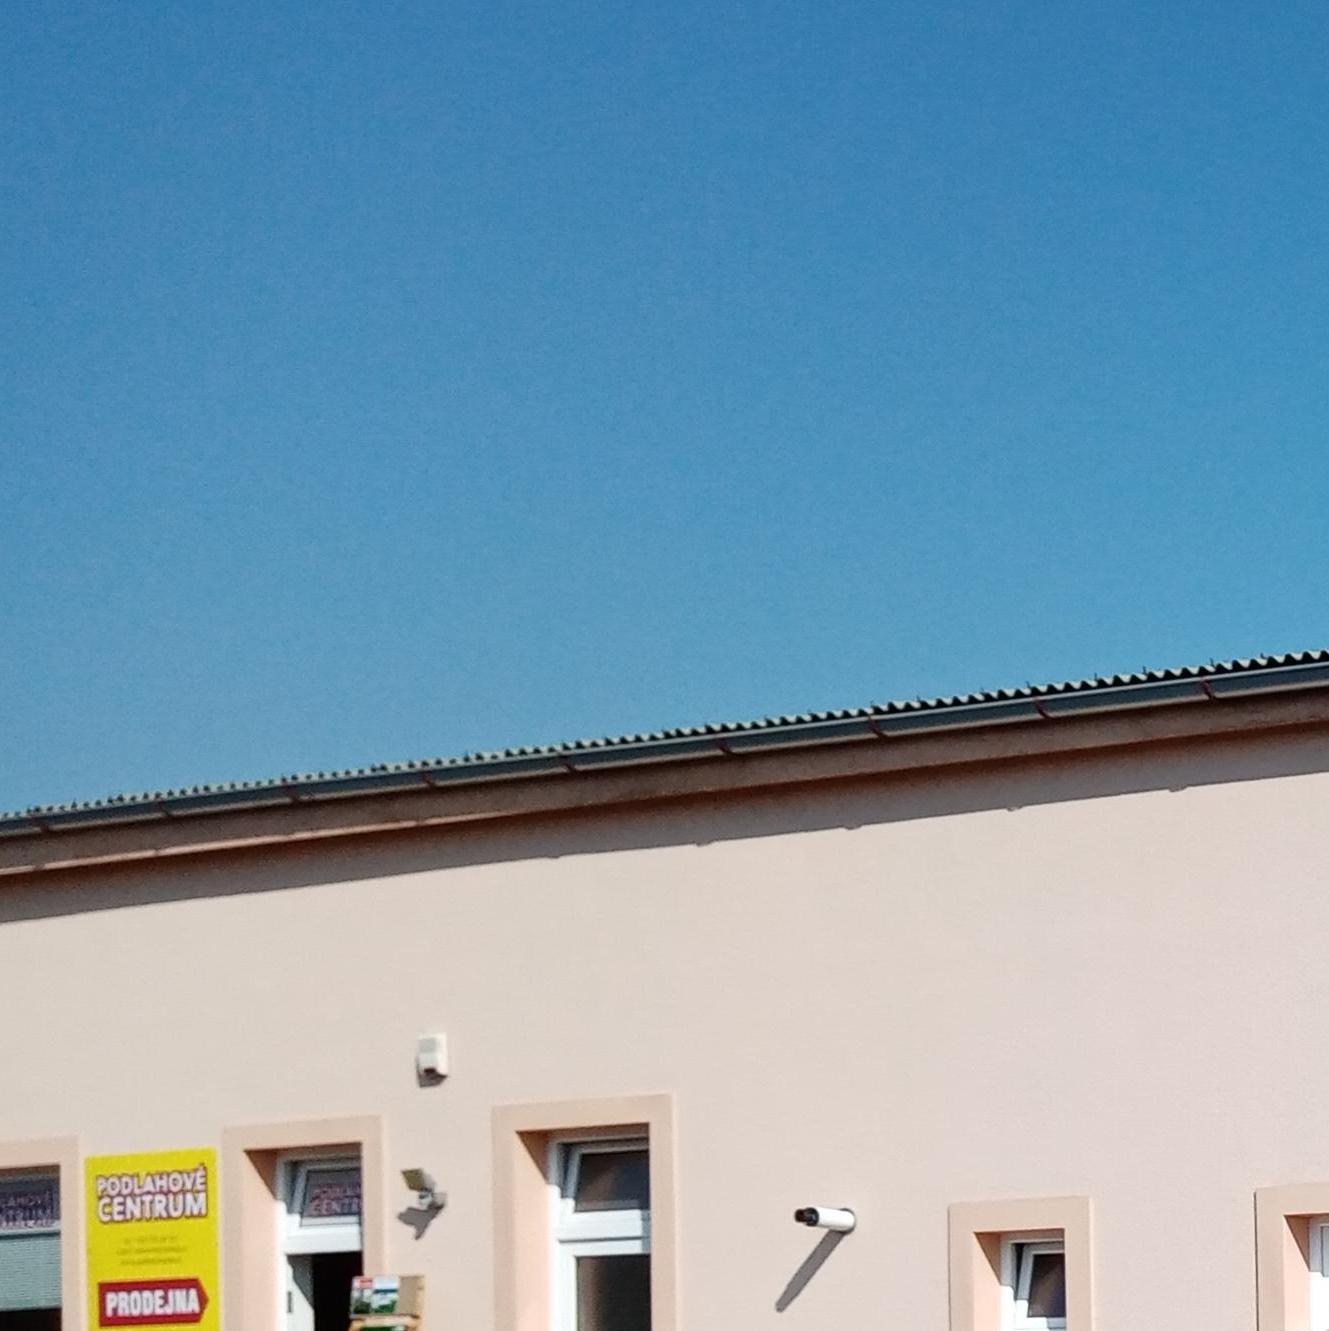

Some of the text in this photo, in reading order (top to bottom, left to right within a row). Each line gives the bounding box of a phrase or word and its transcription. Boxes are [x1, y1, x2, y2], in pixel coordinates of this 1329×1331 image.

[97, 1164, 206, 1196] PODLAHOVÉ
[99, 1193, 207, 1222] CENTRUM
[105, 1288, 200, 1317] PRODEJNA
